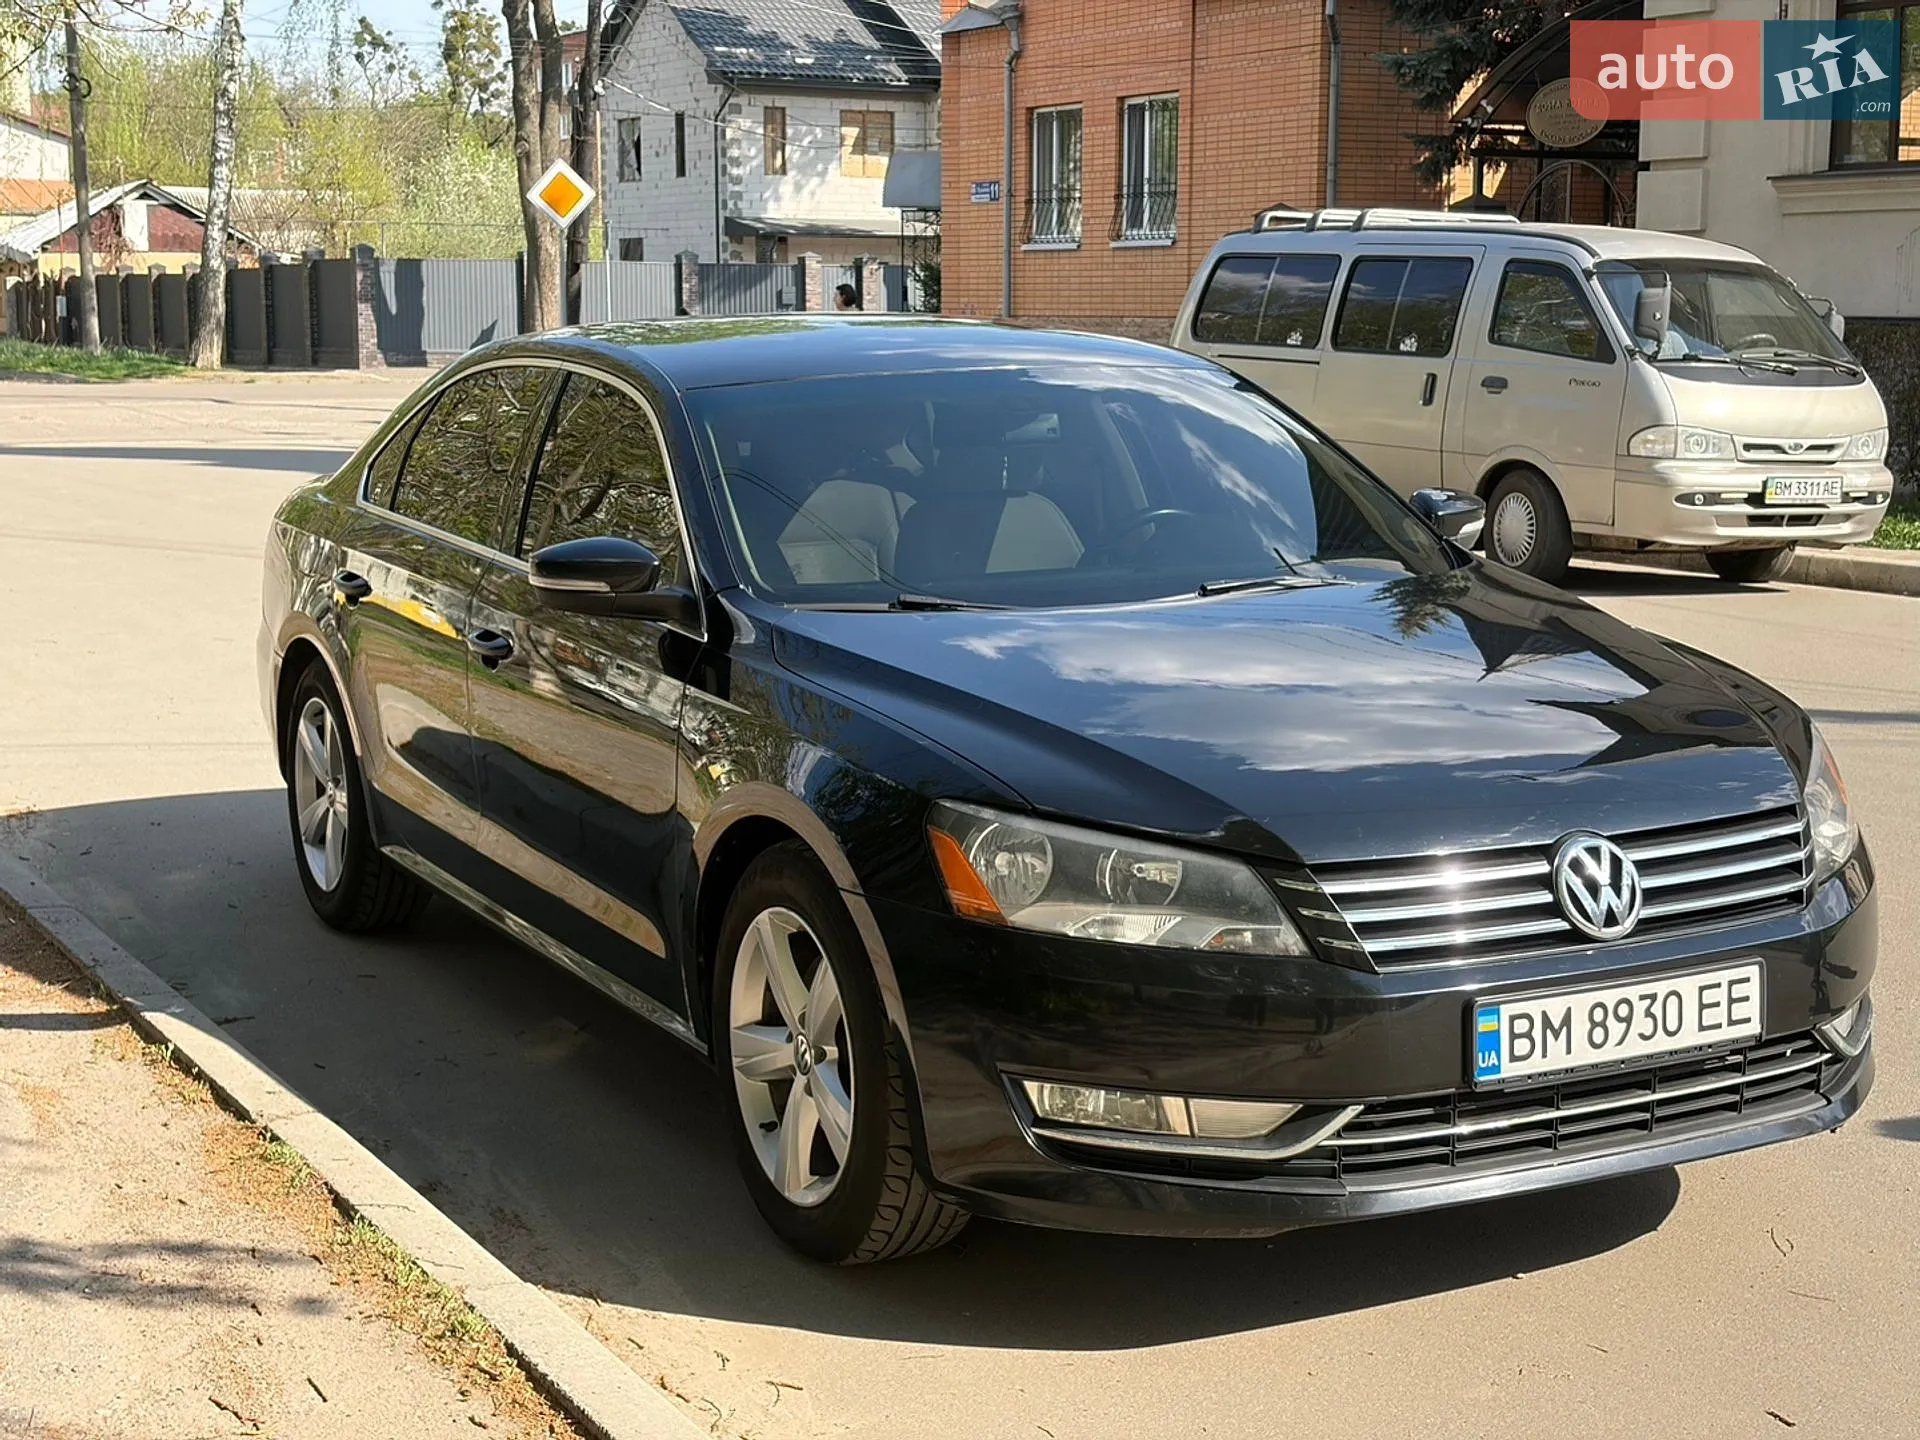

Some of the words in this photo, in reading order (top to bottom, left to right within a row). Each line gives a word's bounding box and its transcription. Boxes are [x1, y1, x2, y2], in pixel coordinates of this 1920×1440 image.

[990, 183, 999, 199] 11
[1774, 481, 1792, 496] BM
[1794, 481, 1821, 496] 3311
[1822, 481, 1839, 496] AE
[1508, 1006, 1572, 1064] BM
[1587, 989, 1683, 1050] 8930
[1697, 976, 1752, 1033] EE
[1478, 1050, 1499, 1068] UA
